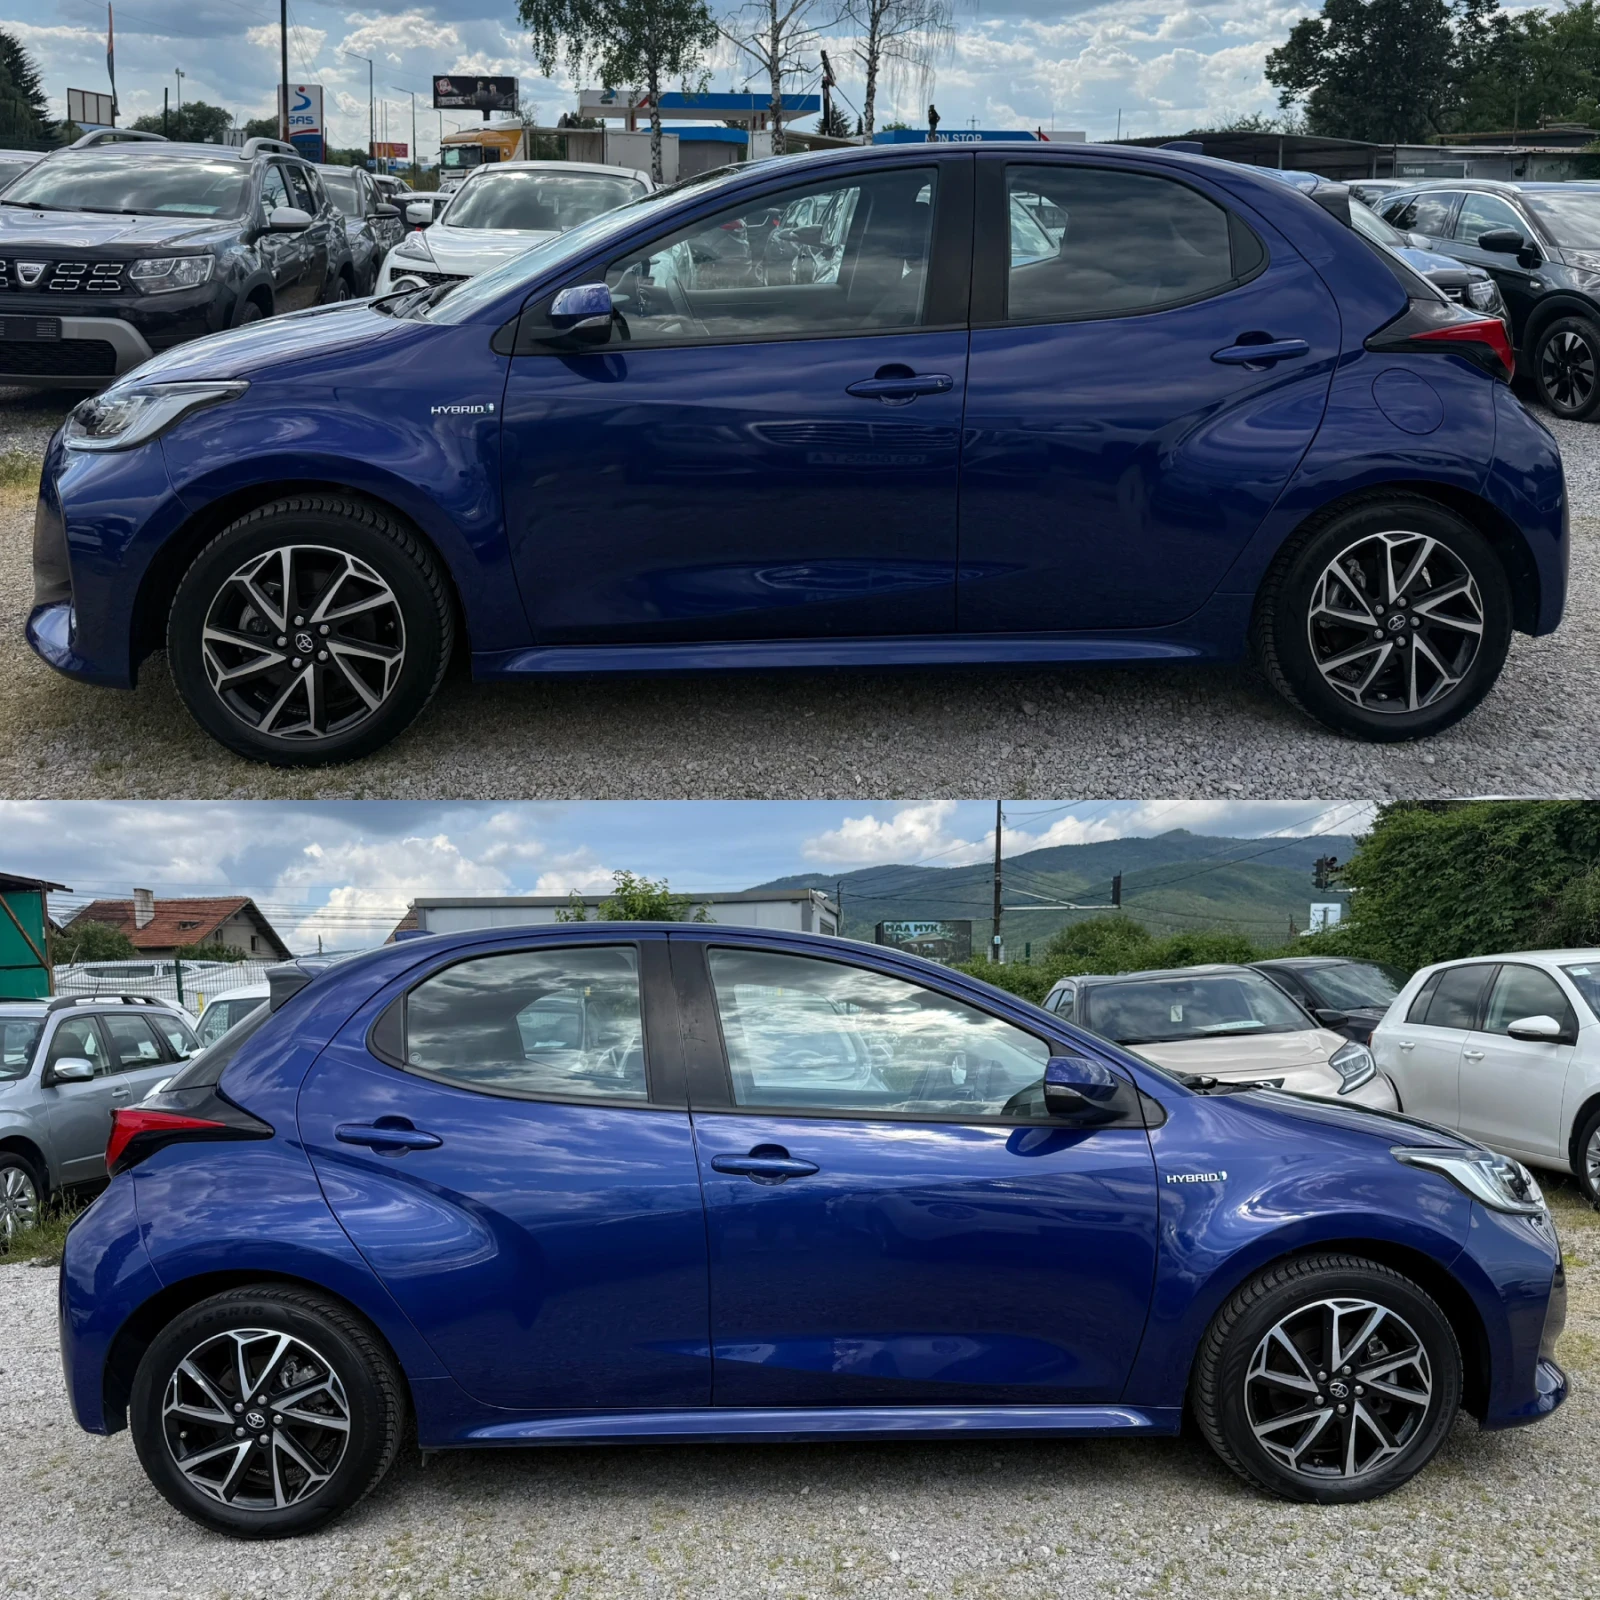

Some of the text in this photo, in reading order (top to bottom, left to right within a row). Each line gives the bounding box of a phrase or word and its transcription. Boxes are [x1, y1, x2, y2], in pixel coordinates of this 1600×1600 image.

[288, 115, 314, 125] GAS
[952, 133, 982, 143] STOP
[430, 405, 484, 415] HYBRID
[1166, 1173, 1218, 1184] HYBRID
